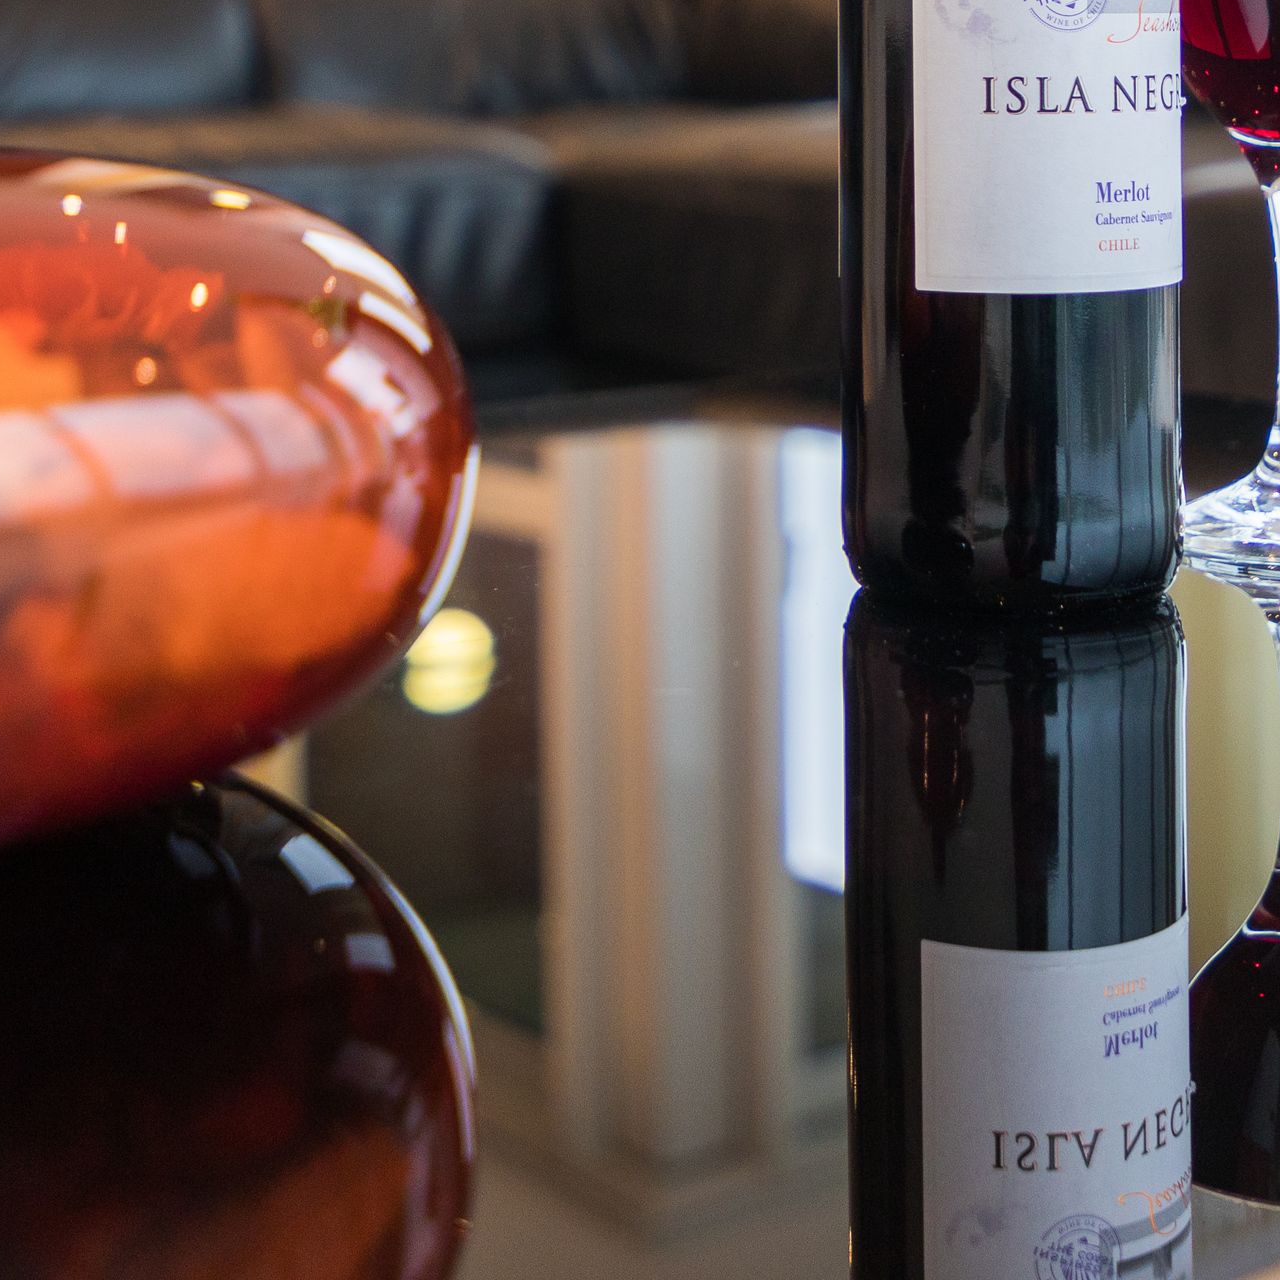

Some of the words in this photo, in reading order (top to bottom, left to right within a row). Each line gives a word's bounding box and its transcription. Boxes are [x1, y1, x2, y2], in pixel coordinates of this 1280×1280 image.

[1046, 13, 1070, 27] WINE
[1073, 18, 1085, 26] OF
[982, 75, 1096, 114] ISLA
[1095, 180, 1150, 204] Merlot
[1095, 212, 1139, 226] Cabernet
[1098, 237, 1141, 252] CHILE
